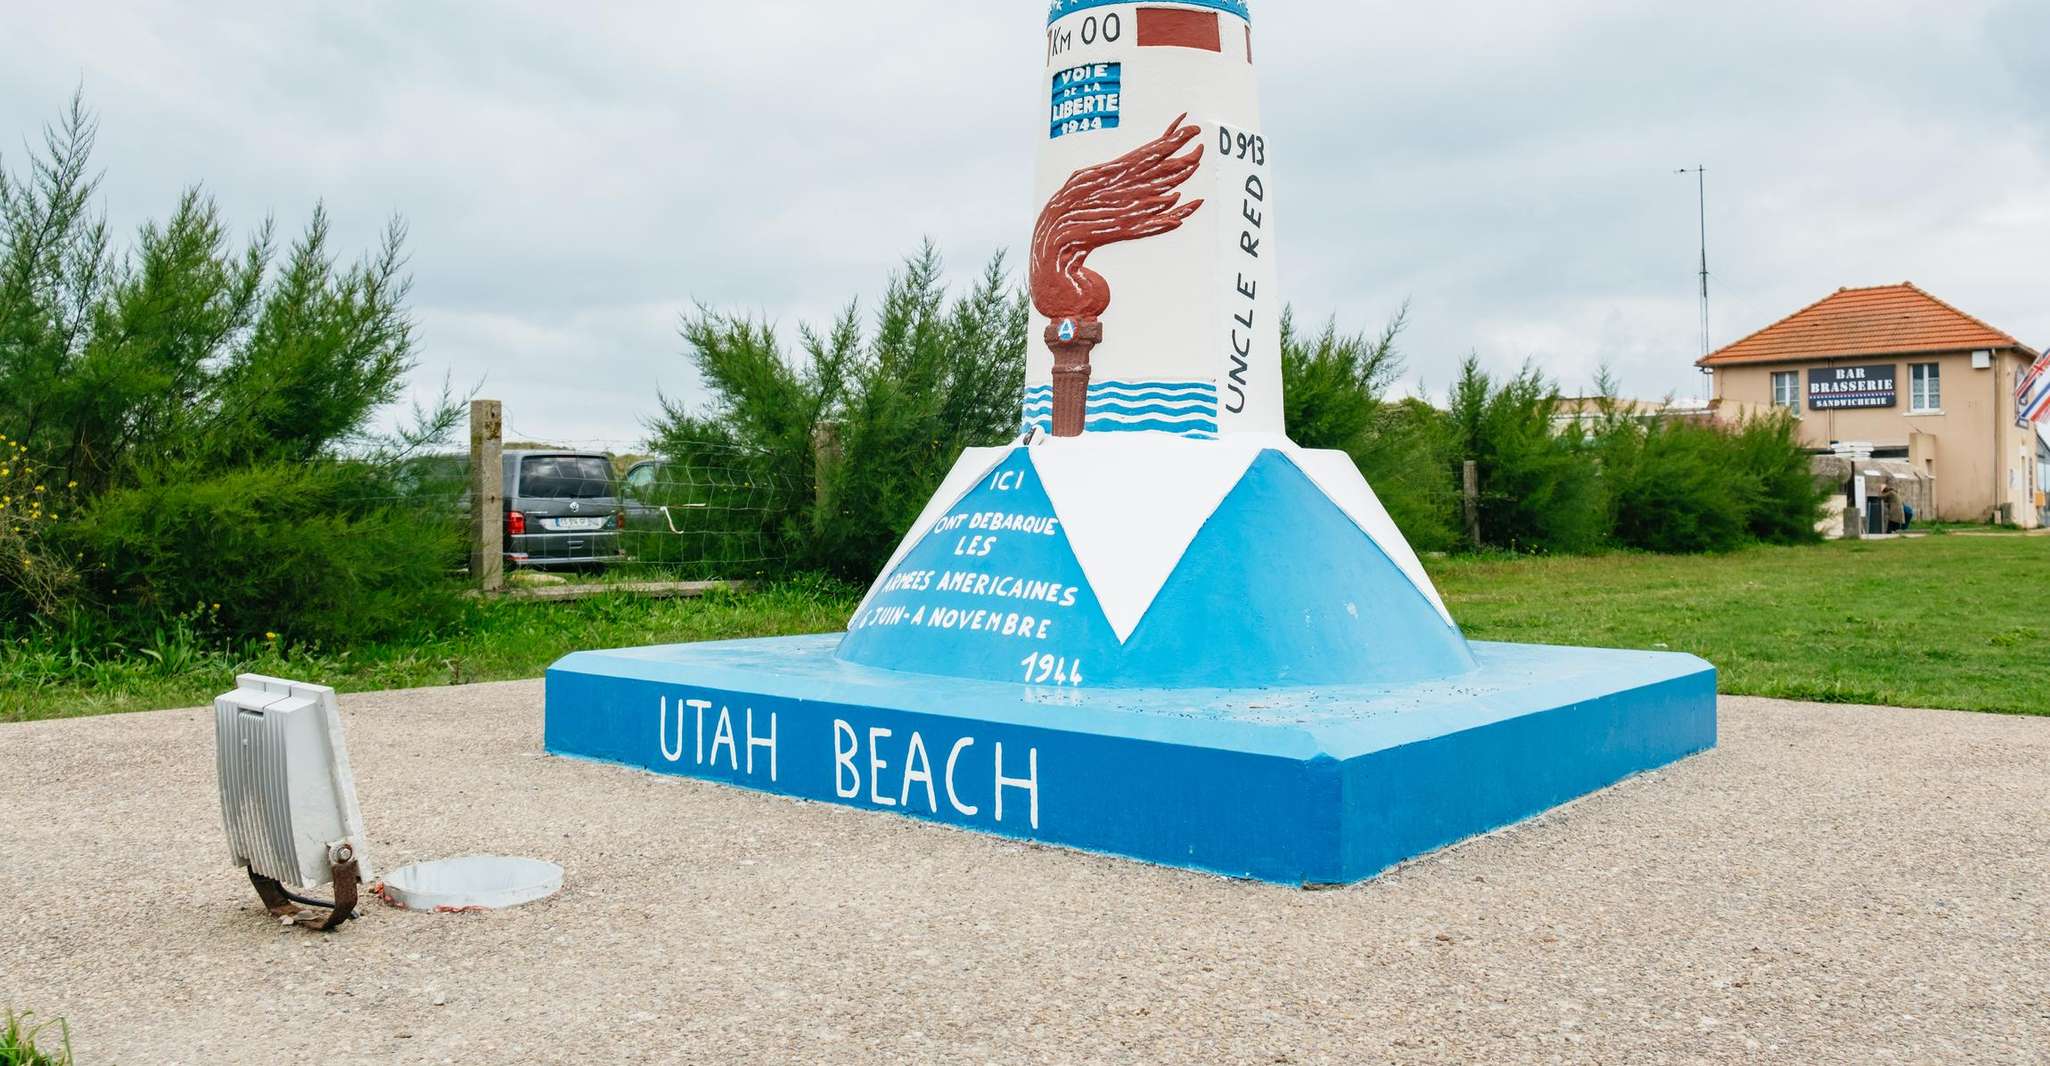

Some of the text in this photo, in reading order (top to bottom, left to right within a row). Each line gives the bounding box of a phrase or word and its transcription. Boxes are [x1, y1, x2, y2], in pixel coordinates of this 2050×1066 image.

[1061, 64, 1108, 84] VOIE
[1064, 82, 1101, 98] DE LA
[1053, 94, 1119, 121] LIBERTE
[1061, 117, 1102, 135] 1944
[1236, 132, 1264, 166] 913
[1225, 174, 1263, 414] UNCLE RED
[1835, 368, 1866, 380] BAR
[1810, 379, 1894, 393] BRASSERIE
[1816, 398, 1888, 408] SANDWICHERIE
[990, 470, 1025, 491] ICI
[933, 512, 1059, 536] ONT DEBARQUE
[954, 535, 997, 557] LES
[881, 570, 1079, 607] ARMEES AMERICAINES
[928, 606, 1052, 639] NOVEMBRE
[1021, 651, 1083, 686] 1944
[660, 695, 1039, 829] UTAH BEACH
